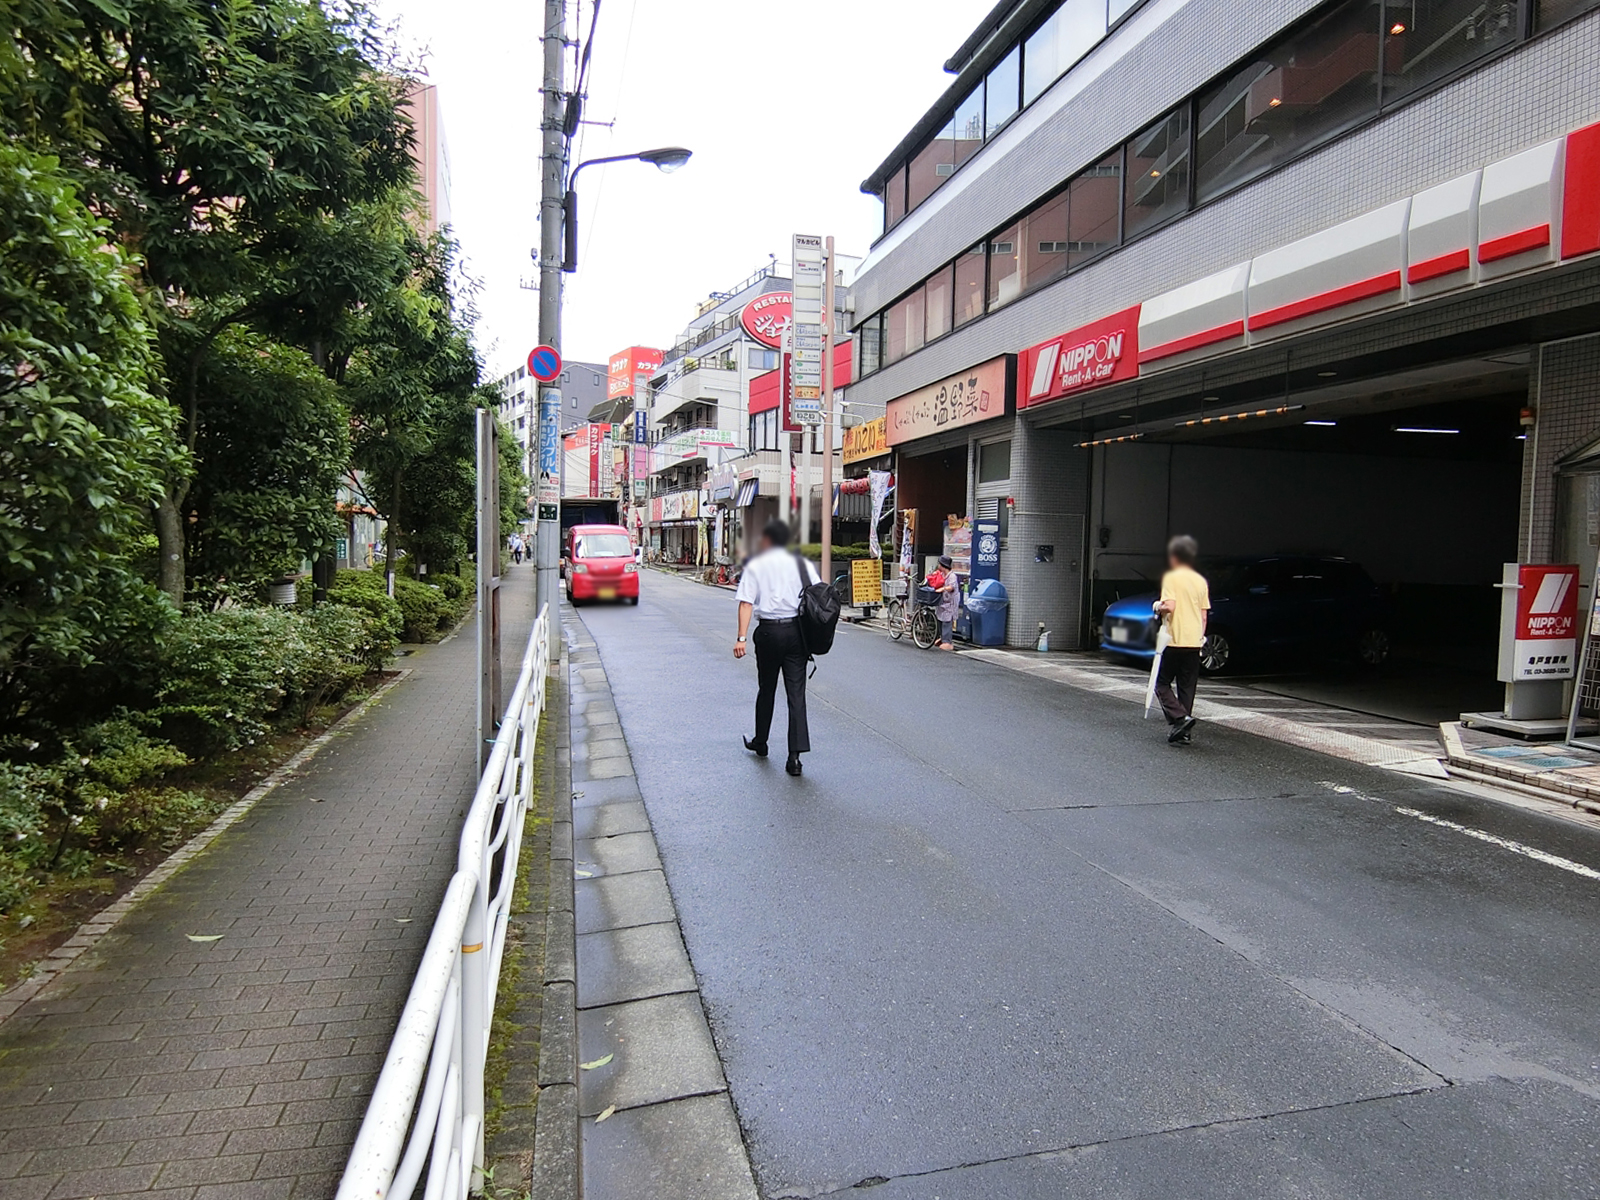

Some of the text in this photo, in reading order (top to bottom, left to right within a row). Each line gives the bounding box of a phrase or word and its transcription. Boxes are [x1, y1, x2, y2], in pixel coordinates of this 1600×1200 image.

[796, 238, 820, 246] マルカビル
[753, 296, 792, 311] RESTA
[1059, 333, 1122, 375] NIPPON
[590, 427, 598, 456] カラオケ
[978, 554, 998, 562] BOSS
[1527, 616, 1572, 629] NIPPON
